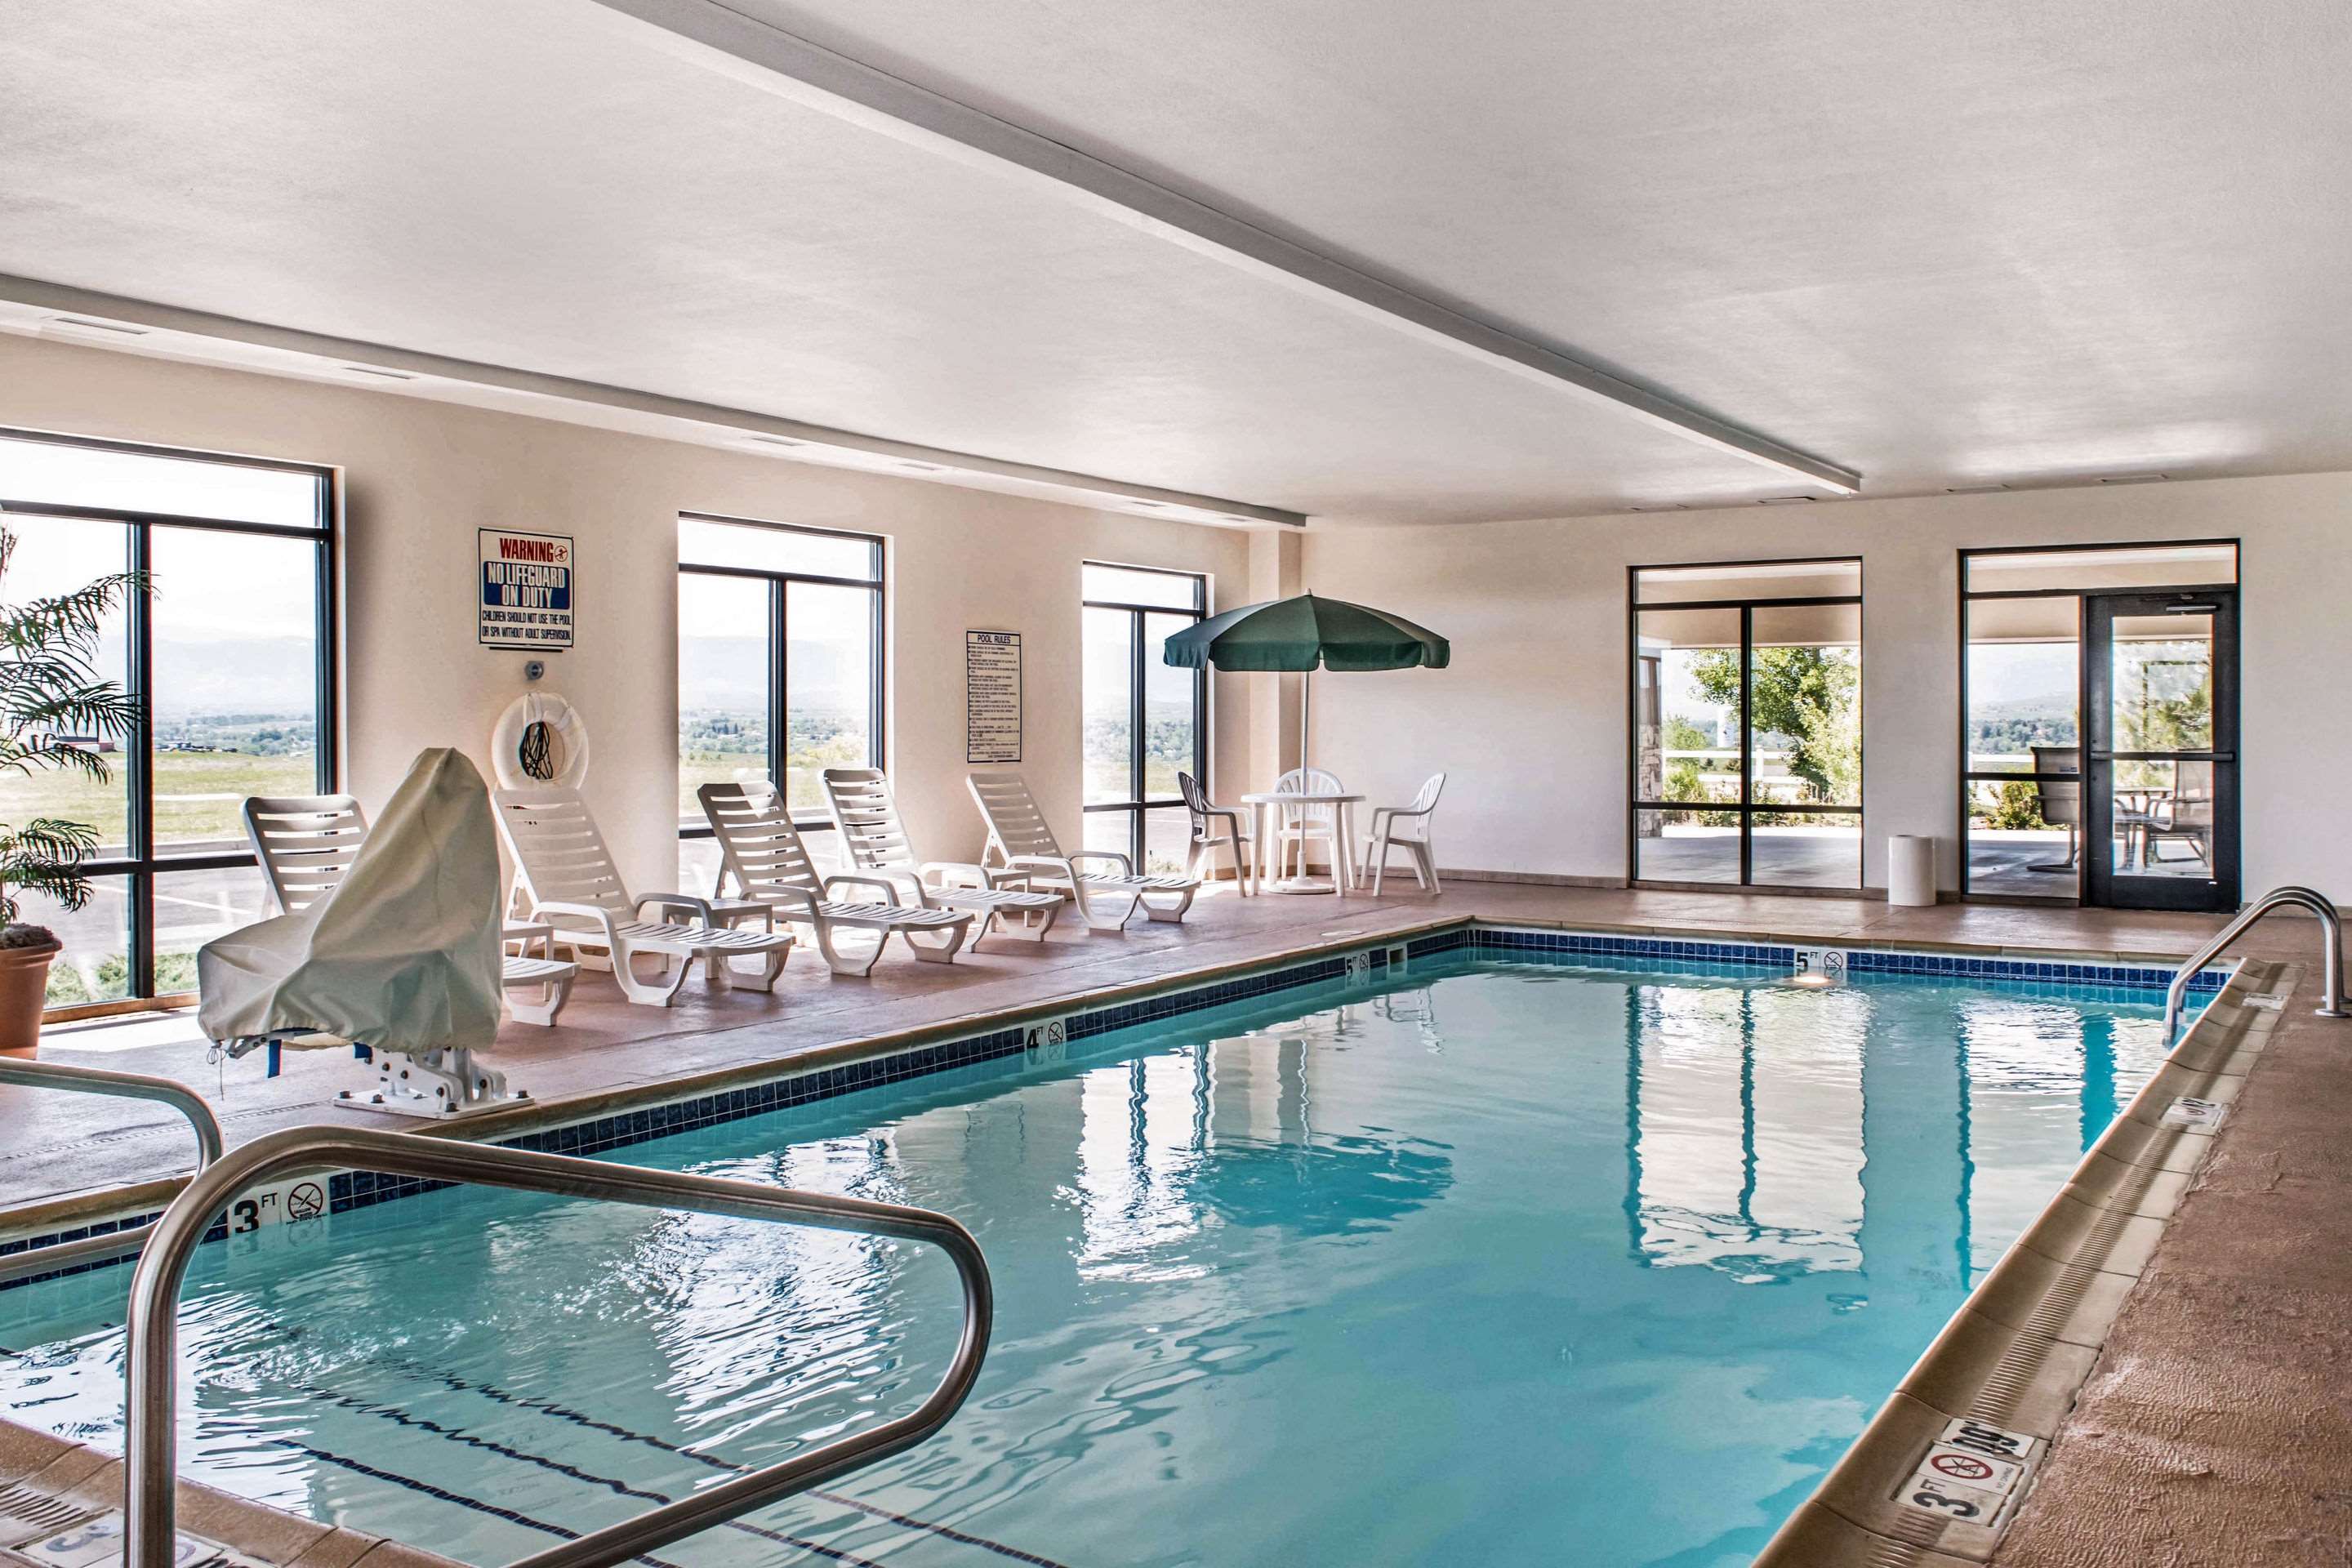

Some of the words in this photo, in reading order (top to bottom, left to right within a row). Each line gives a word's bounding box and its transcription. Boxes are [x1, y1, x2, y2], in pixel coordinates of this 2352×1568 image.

[499, 537, 554, 563] WARNING
[488, 563, 504, 585] NO
[506, 564, 565, 588] LIFEGUARD
[501, 584, 519, 606] ON
[522, 586, 553, 608] DUTY
[483, 610, 506, 621] CHILDREN
[507, 612, 527, 623] SHOULD
[528, 612, 537, 623] NOT
[538, 613, 548, 624] USE
[549, 614, 559, 625] THE
[559, 614, 571, 626] POOL
[483, 626, 489, 636] OR
[490, 626, 500, 637] SPA
[501, 627, 523, 638] WITHOUT
[525, 628, 539, 639] ADULT
[977, 634, 992, 643] POOL
[994, 635, 1011, 644] RULES
[1347, 959, 1352, 973] 5
[1797, 952, 1808, 968] 5
[1027, 1029, 1039, 1049] 4
[1037, 1027, 1043, 1035] FT
[234, 1200, 259, 1233] 3
[261, 1192, 278, 1209] FT
[1919, 1478, 1946, 1493] FT
[1912, 1491, 1981, 1517] 3
